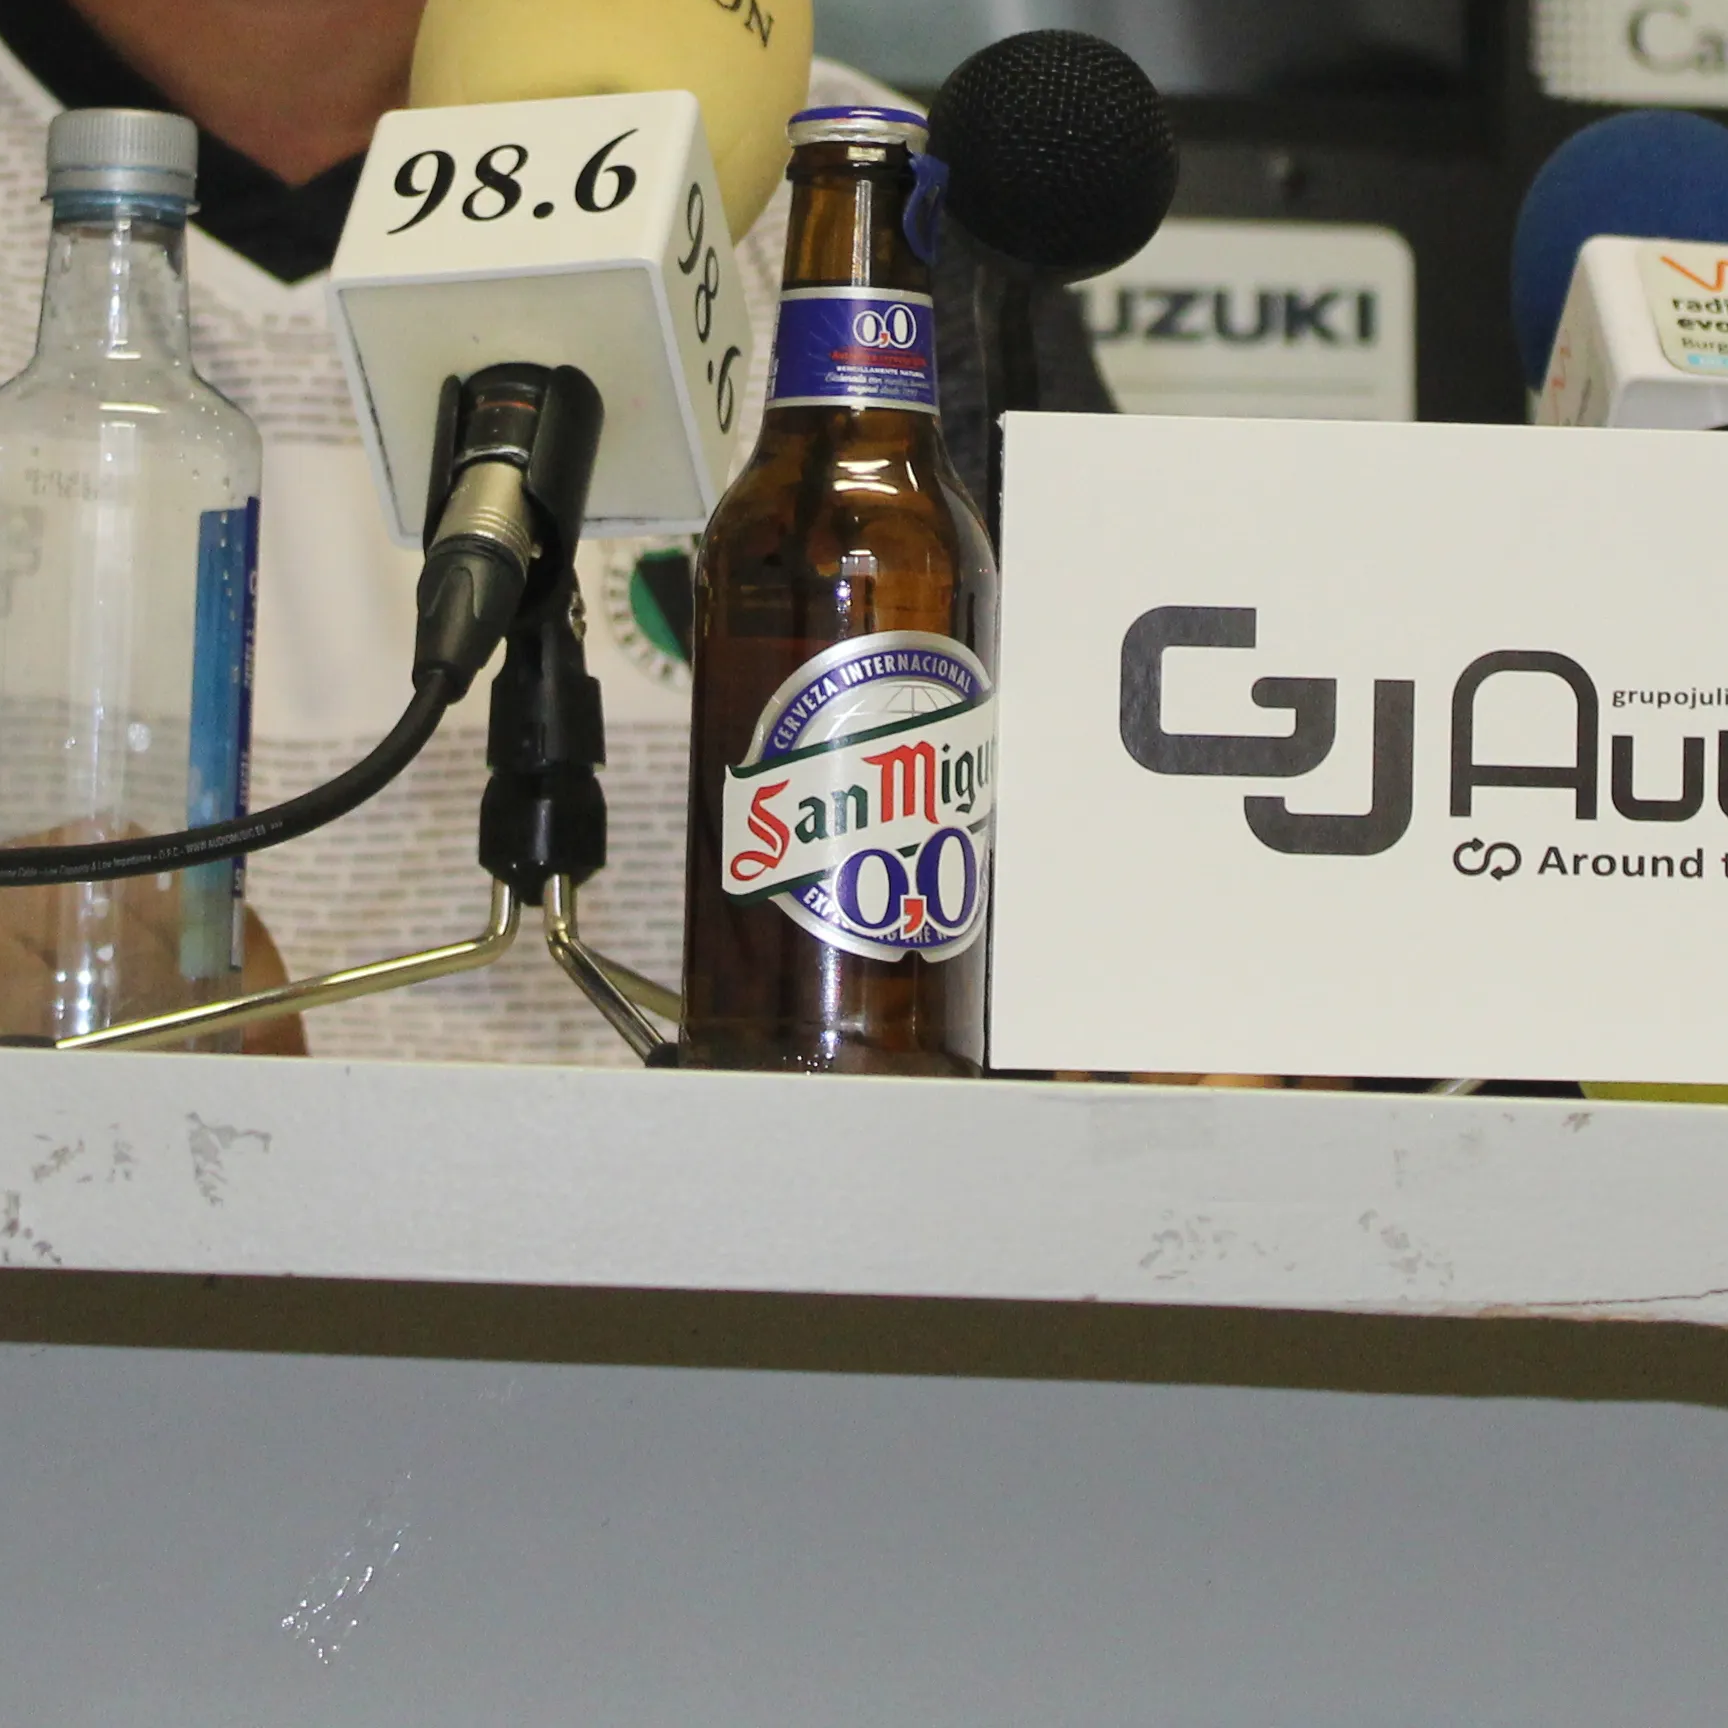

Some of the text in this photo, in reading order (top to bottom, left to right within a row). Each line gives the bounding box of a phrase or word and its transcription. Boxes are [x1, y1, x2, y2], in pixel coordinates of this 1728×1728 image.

[386, 128, 639, 236] 98.6
[1079, 286, 1379, 346] UZUKI
[773, 652, 974, 751] CERVEZA INTERNACIONAL
[1537, 844, 1706, 882] Around
